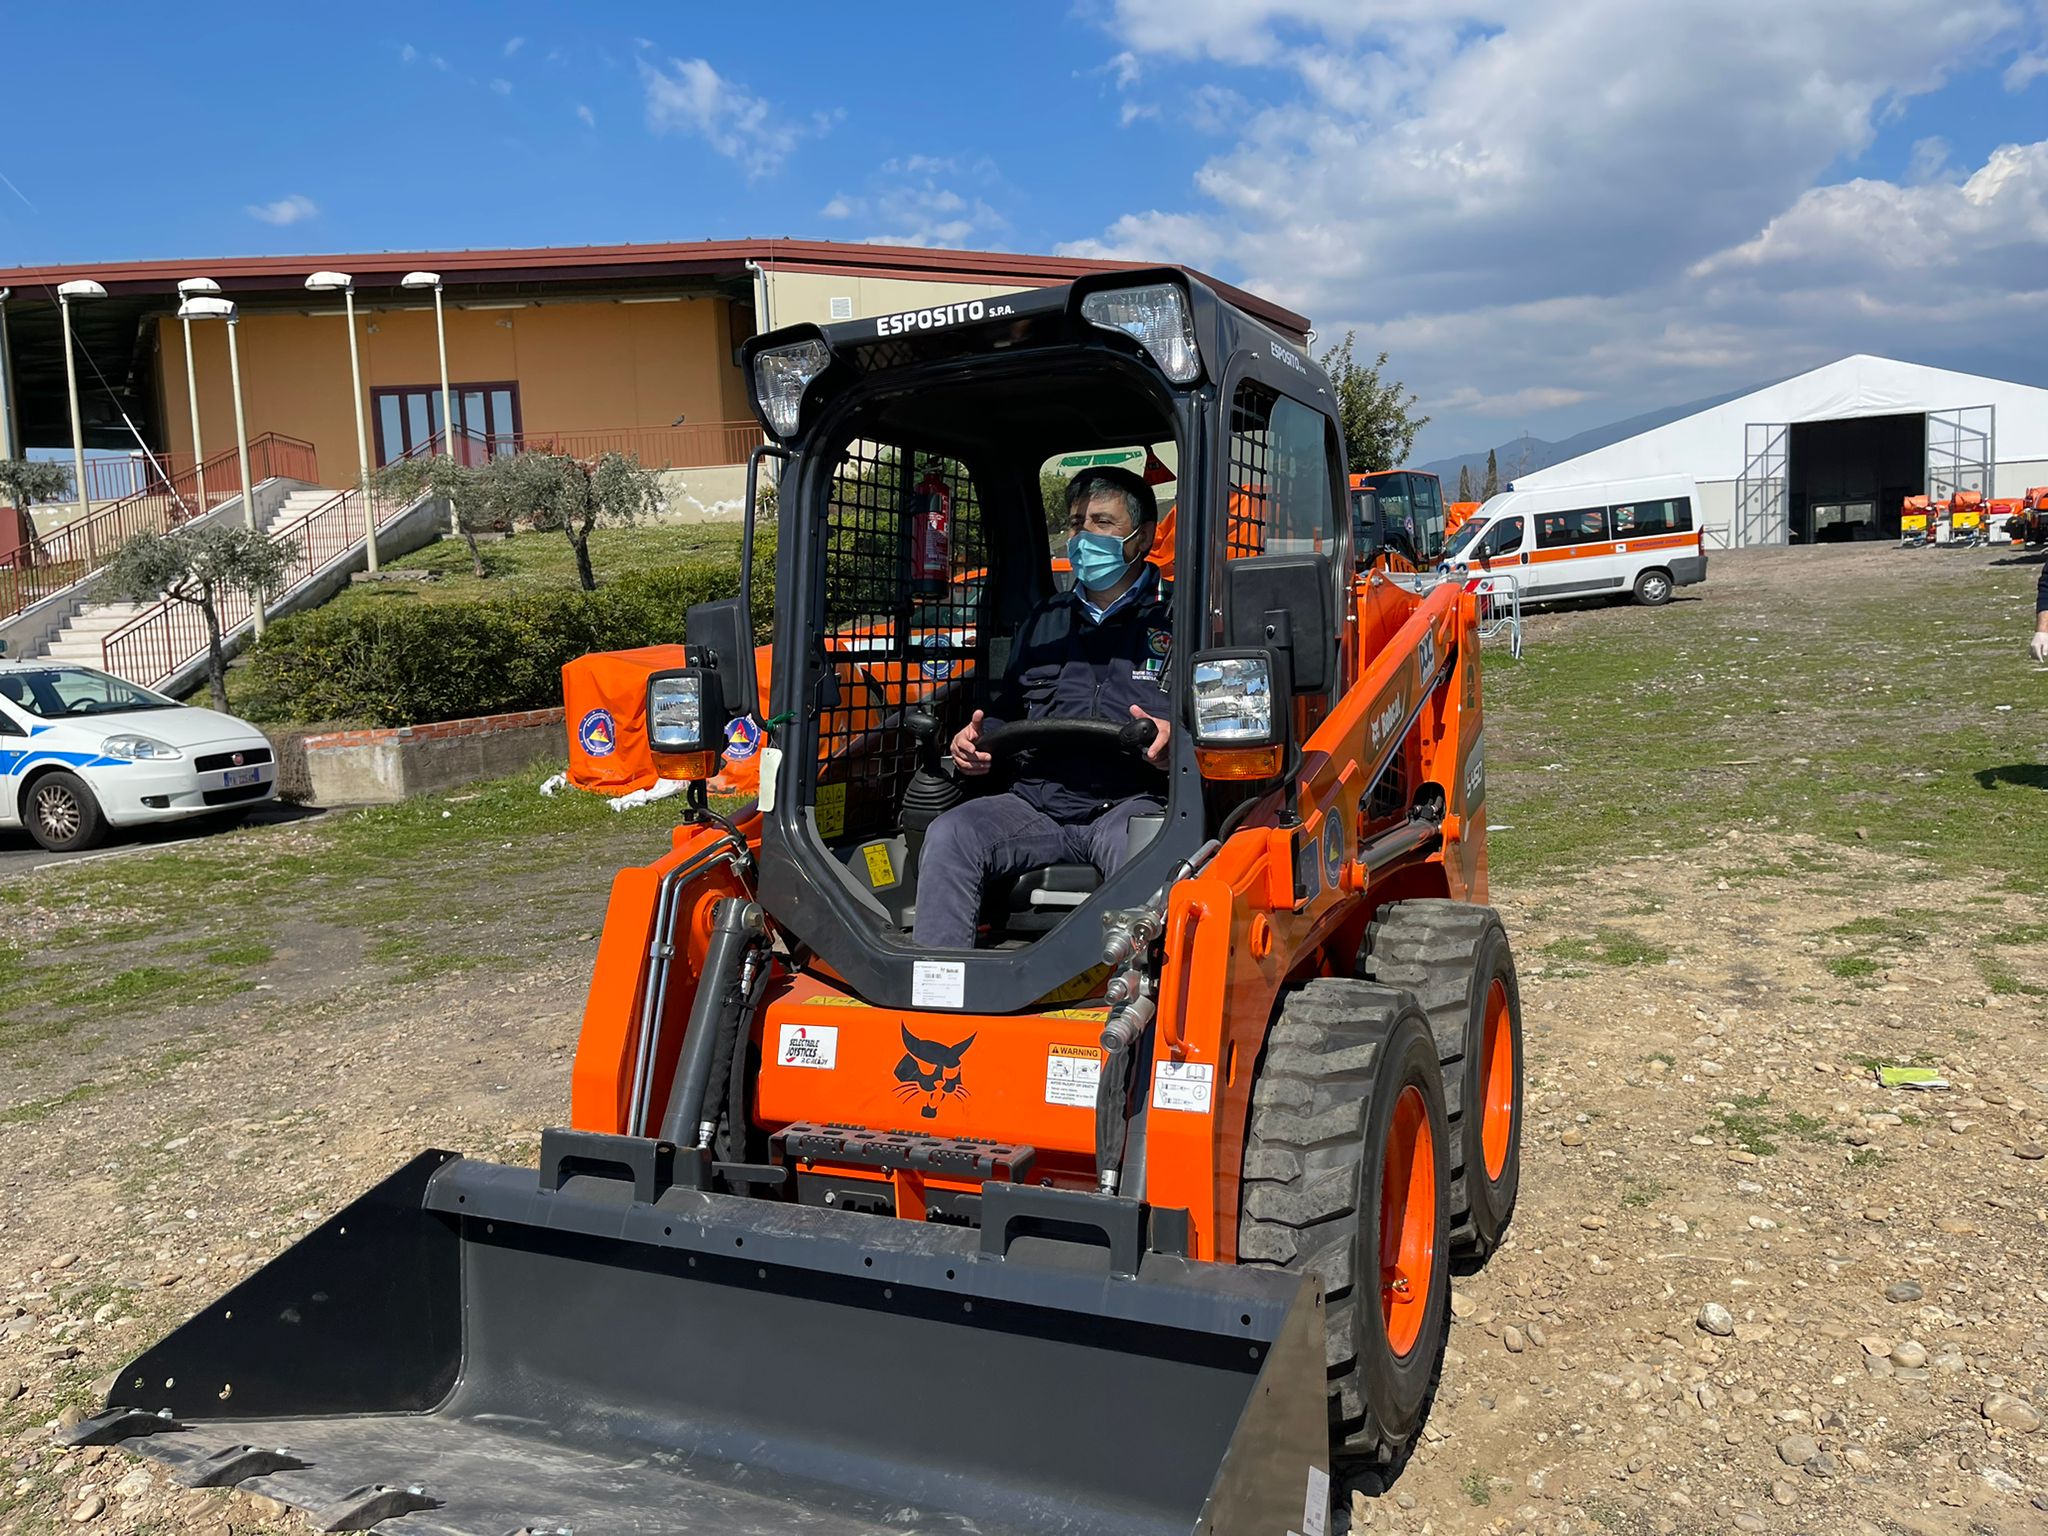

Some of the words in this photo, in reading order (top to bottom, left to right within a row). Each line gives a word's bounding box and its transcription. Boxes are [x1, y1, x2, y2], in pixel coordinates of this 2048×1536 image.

[876, 300, 984, 336] ESPOSITO
[988, 305, 1015, 318] S.P.A.
[1270, 340, 1300, 371] ESPOSITO
[1060, 1047, 1098, 1057] WARNING
